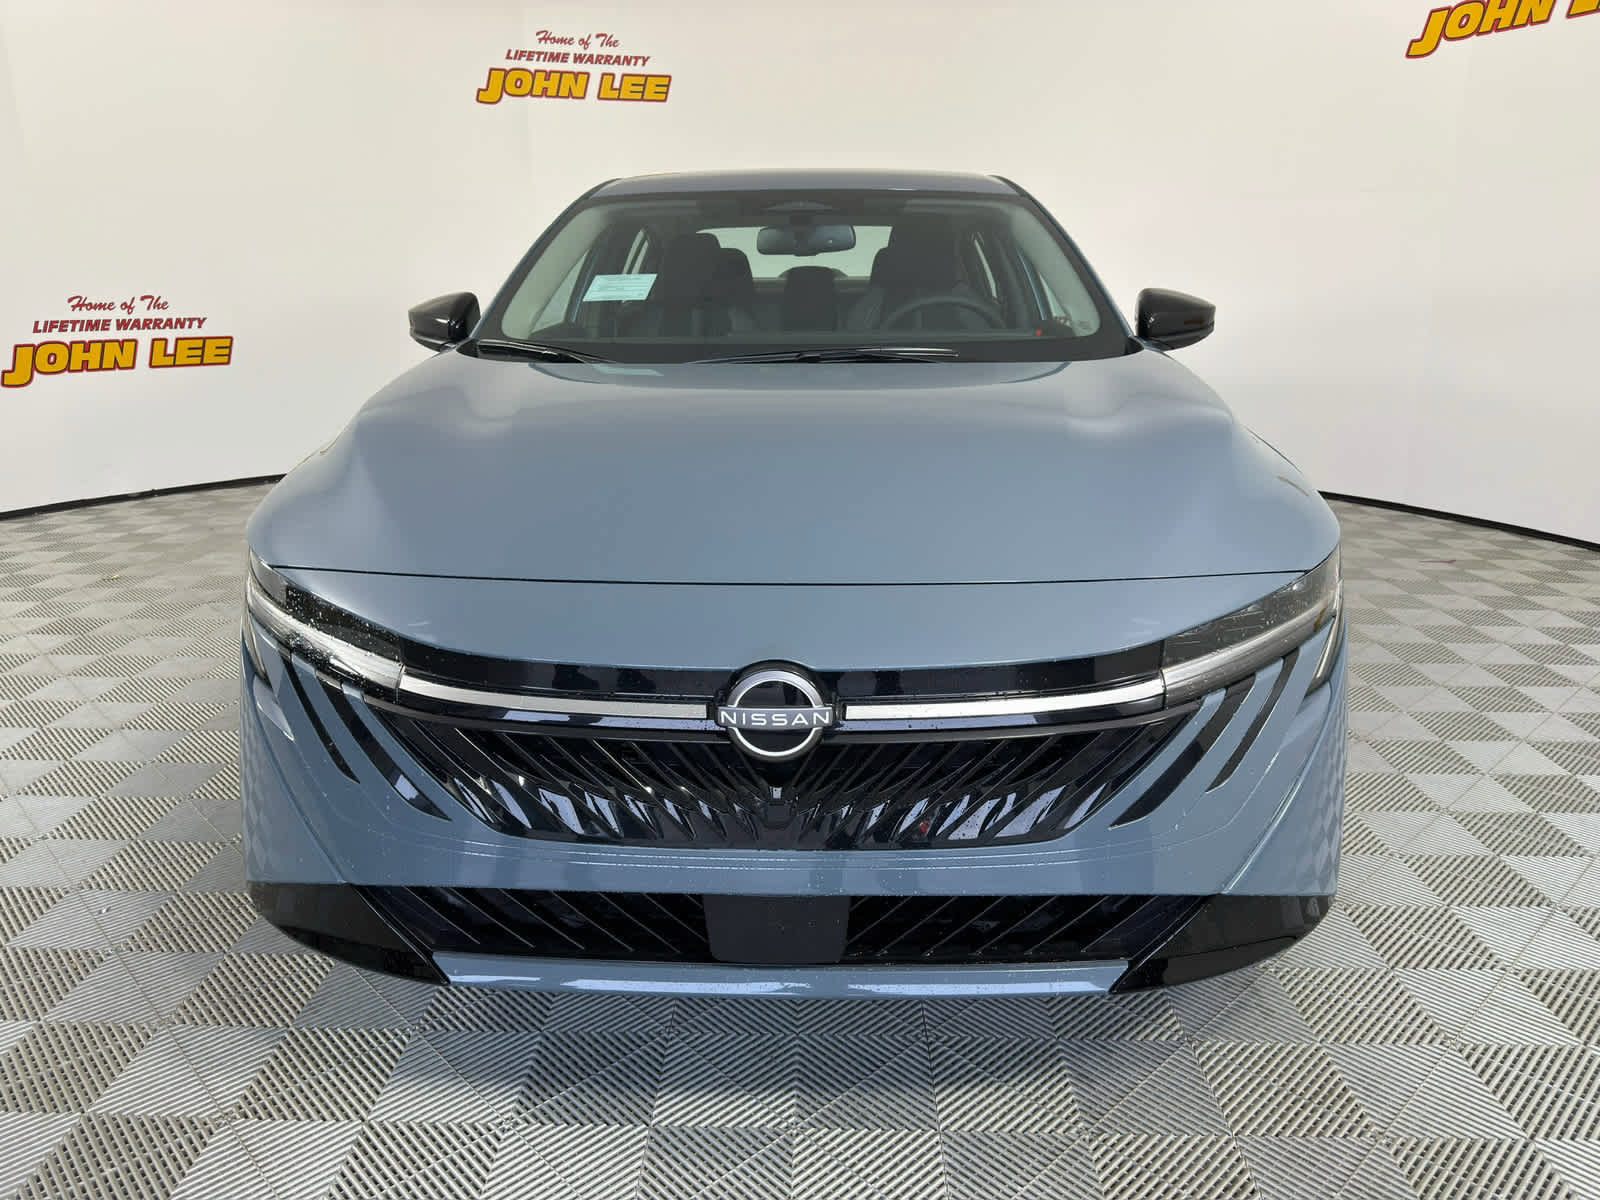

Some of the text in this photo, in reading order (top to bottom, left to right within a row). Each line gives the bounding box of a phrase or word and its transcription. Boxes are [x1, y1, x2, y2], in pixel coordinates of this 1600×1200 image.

[1405, 0, 1556, 58] JOHN
[535, 30, 620, 50] Home of The
[505, 49, 650, 66] LIFETIME WARRANTY
[476, 68, 672, 104] JOHN LEE
[67, 295, 169, 315] Home of The
[32, 317, 207, 333] LIFETIME WARRANTY
[1, 336, 233, 387] JOHN LEE
[720, 711, 829, 726] NISSAN
